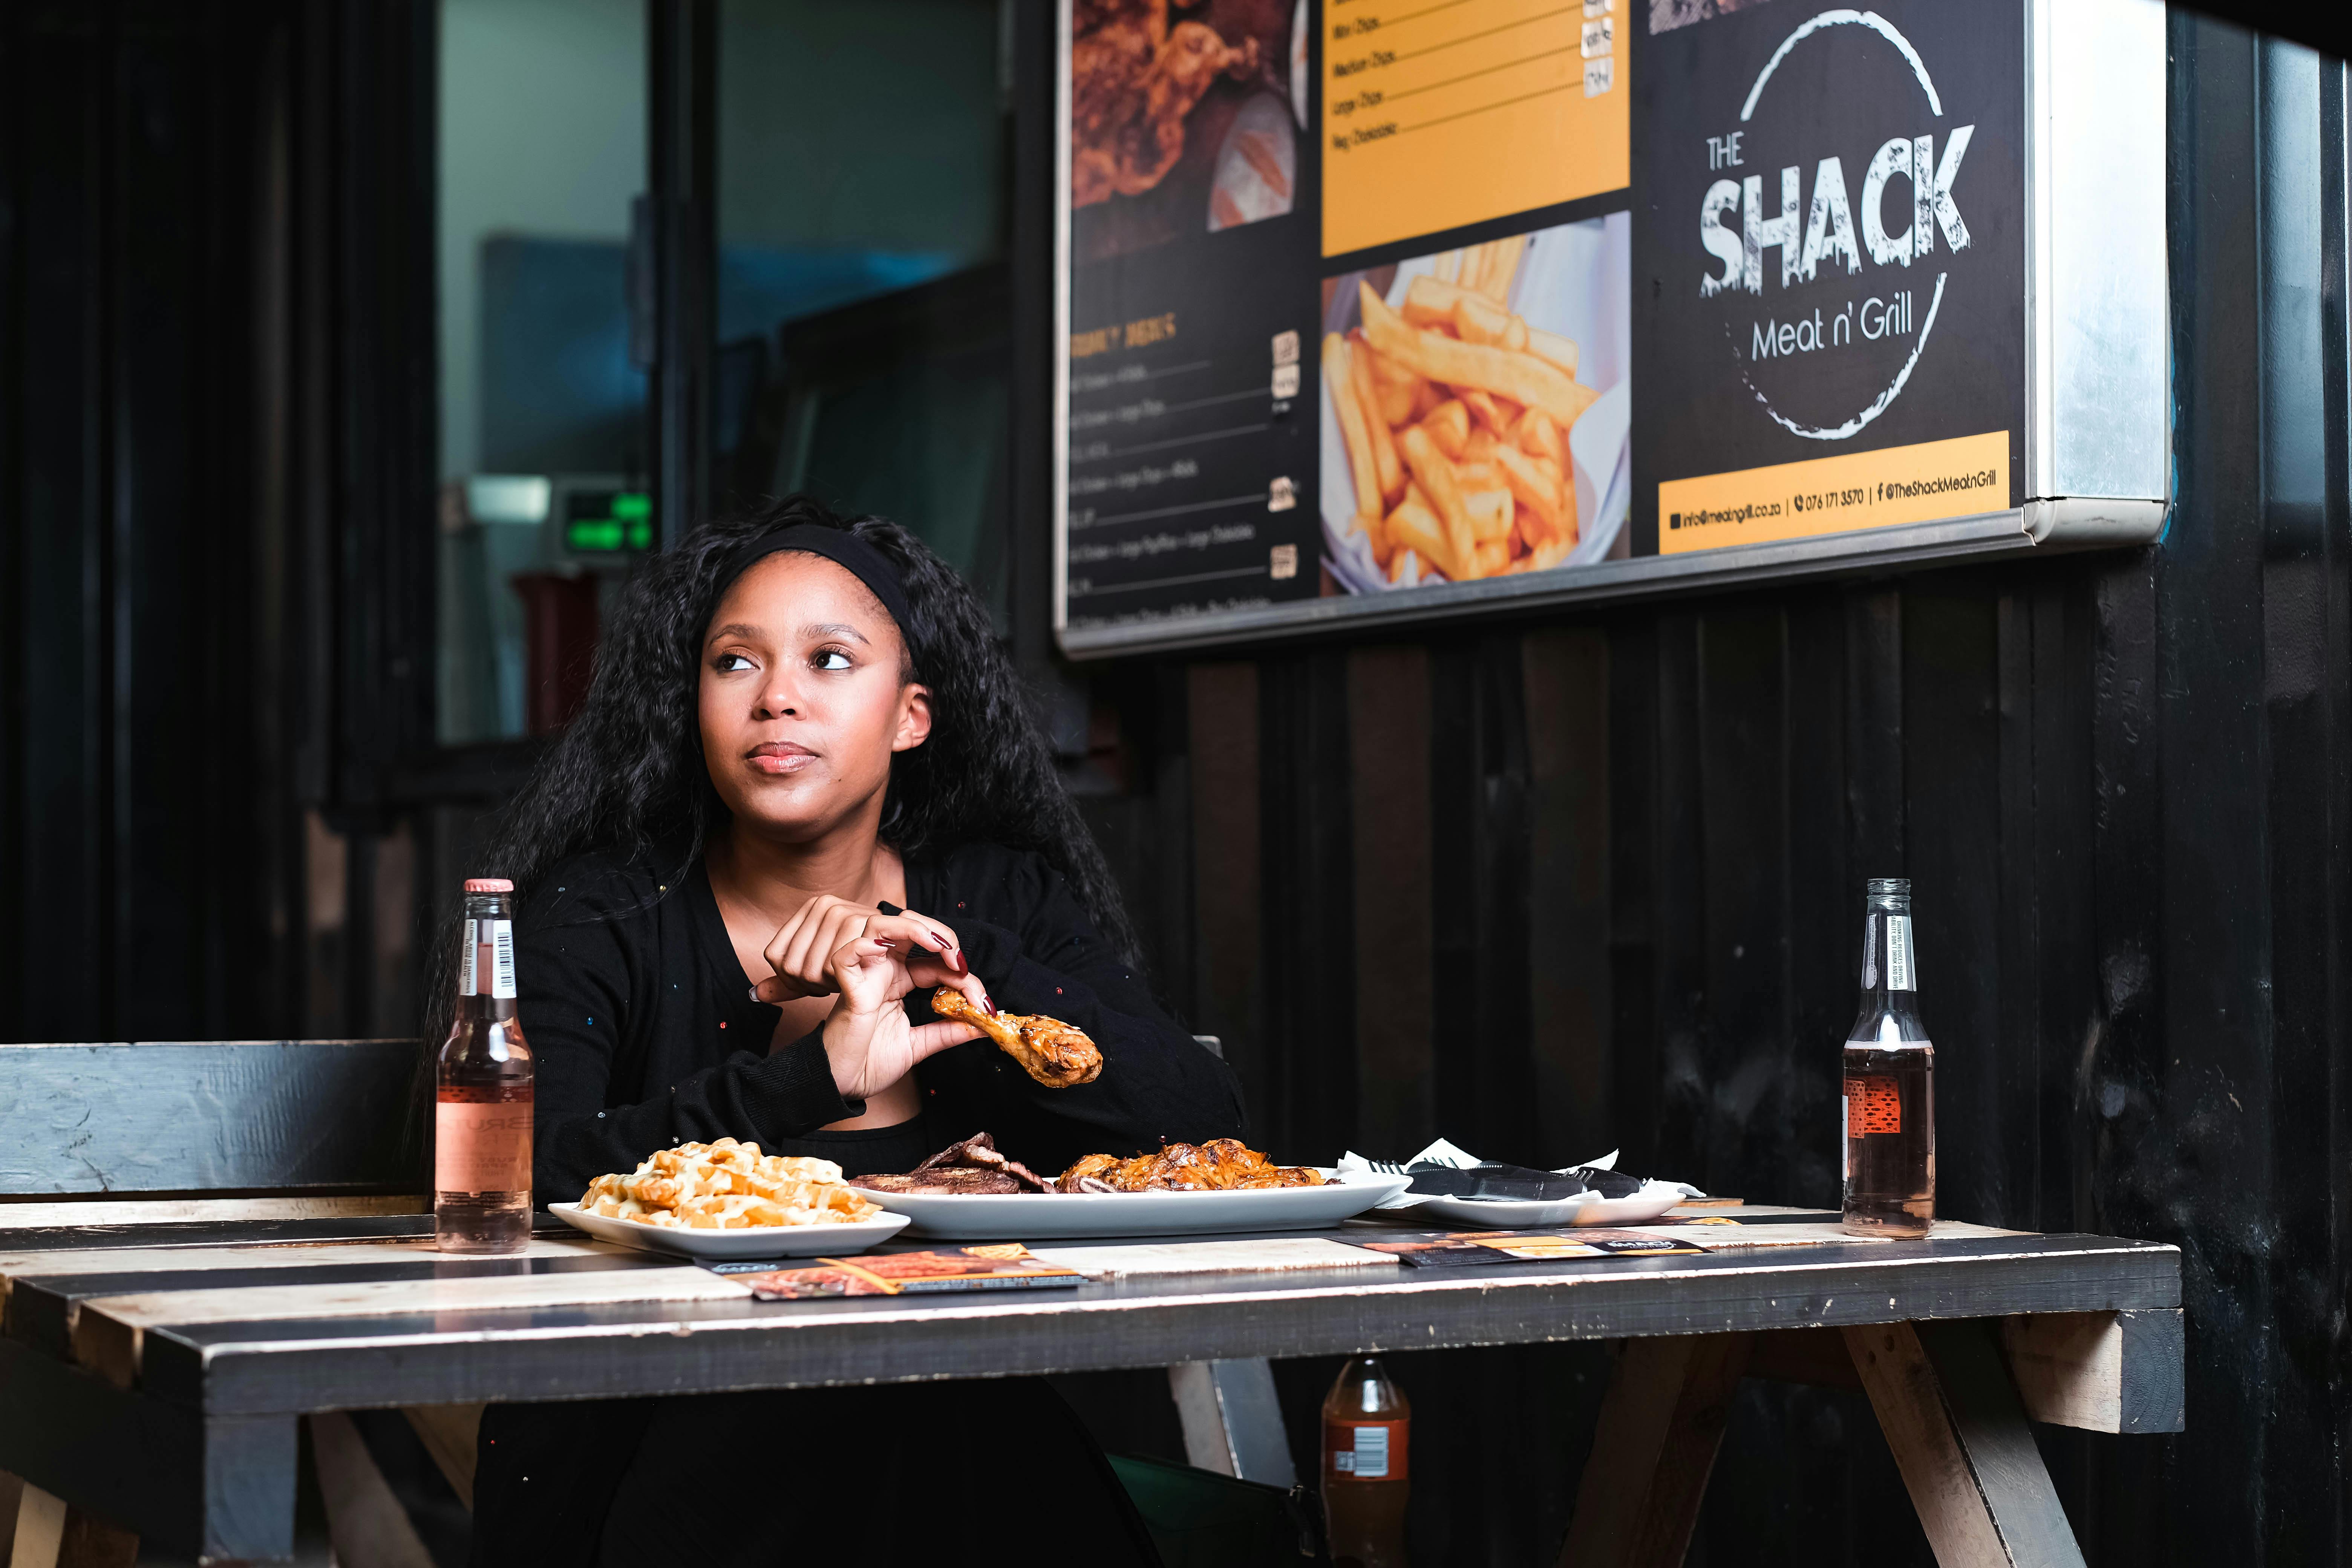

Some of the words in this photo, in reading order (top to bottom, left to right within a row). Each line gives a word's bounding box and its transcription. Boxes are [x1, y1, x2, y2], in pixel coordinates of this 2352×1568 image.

[1706, 131, 1745, 171] THE
[1699, 124, 1975, 299] SHACK
[1752, 308, 1825, 361] Meat
[1860, 290, 1912, 340] Grill
[1805, 495, 1823, 510] 076
[1826, 492, 1838, 508] 171
[1841, 488, 1864, 506] 3570
